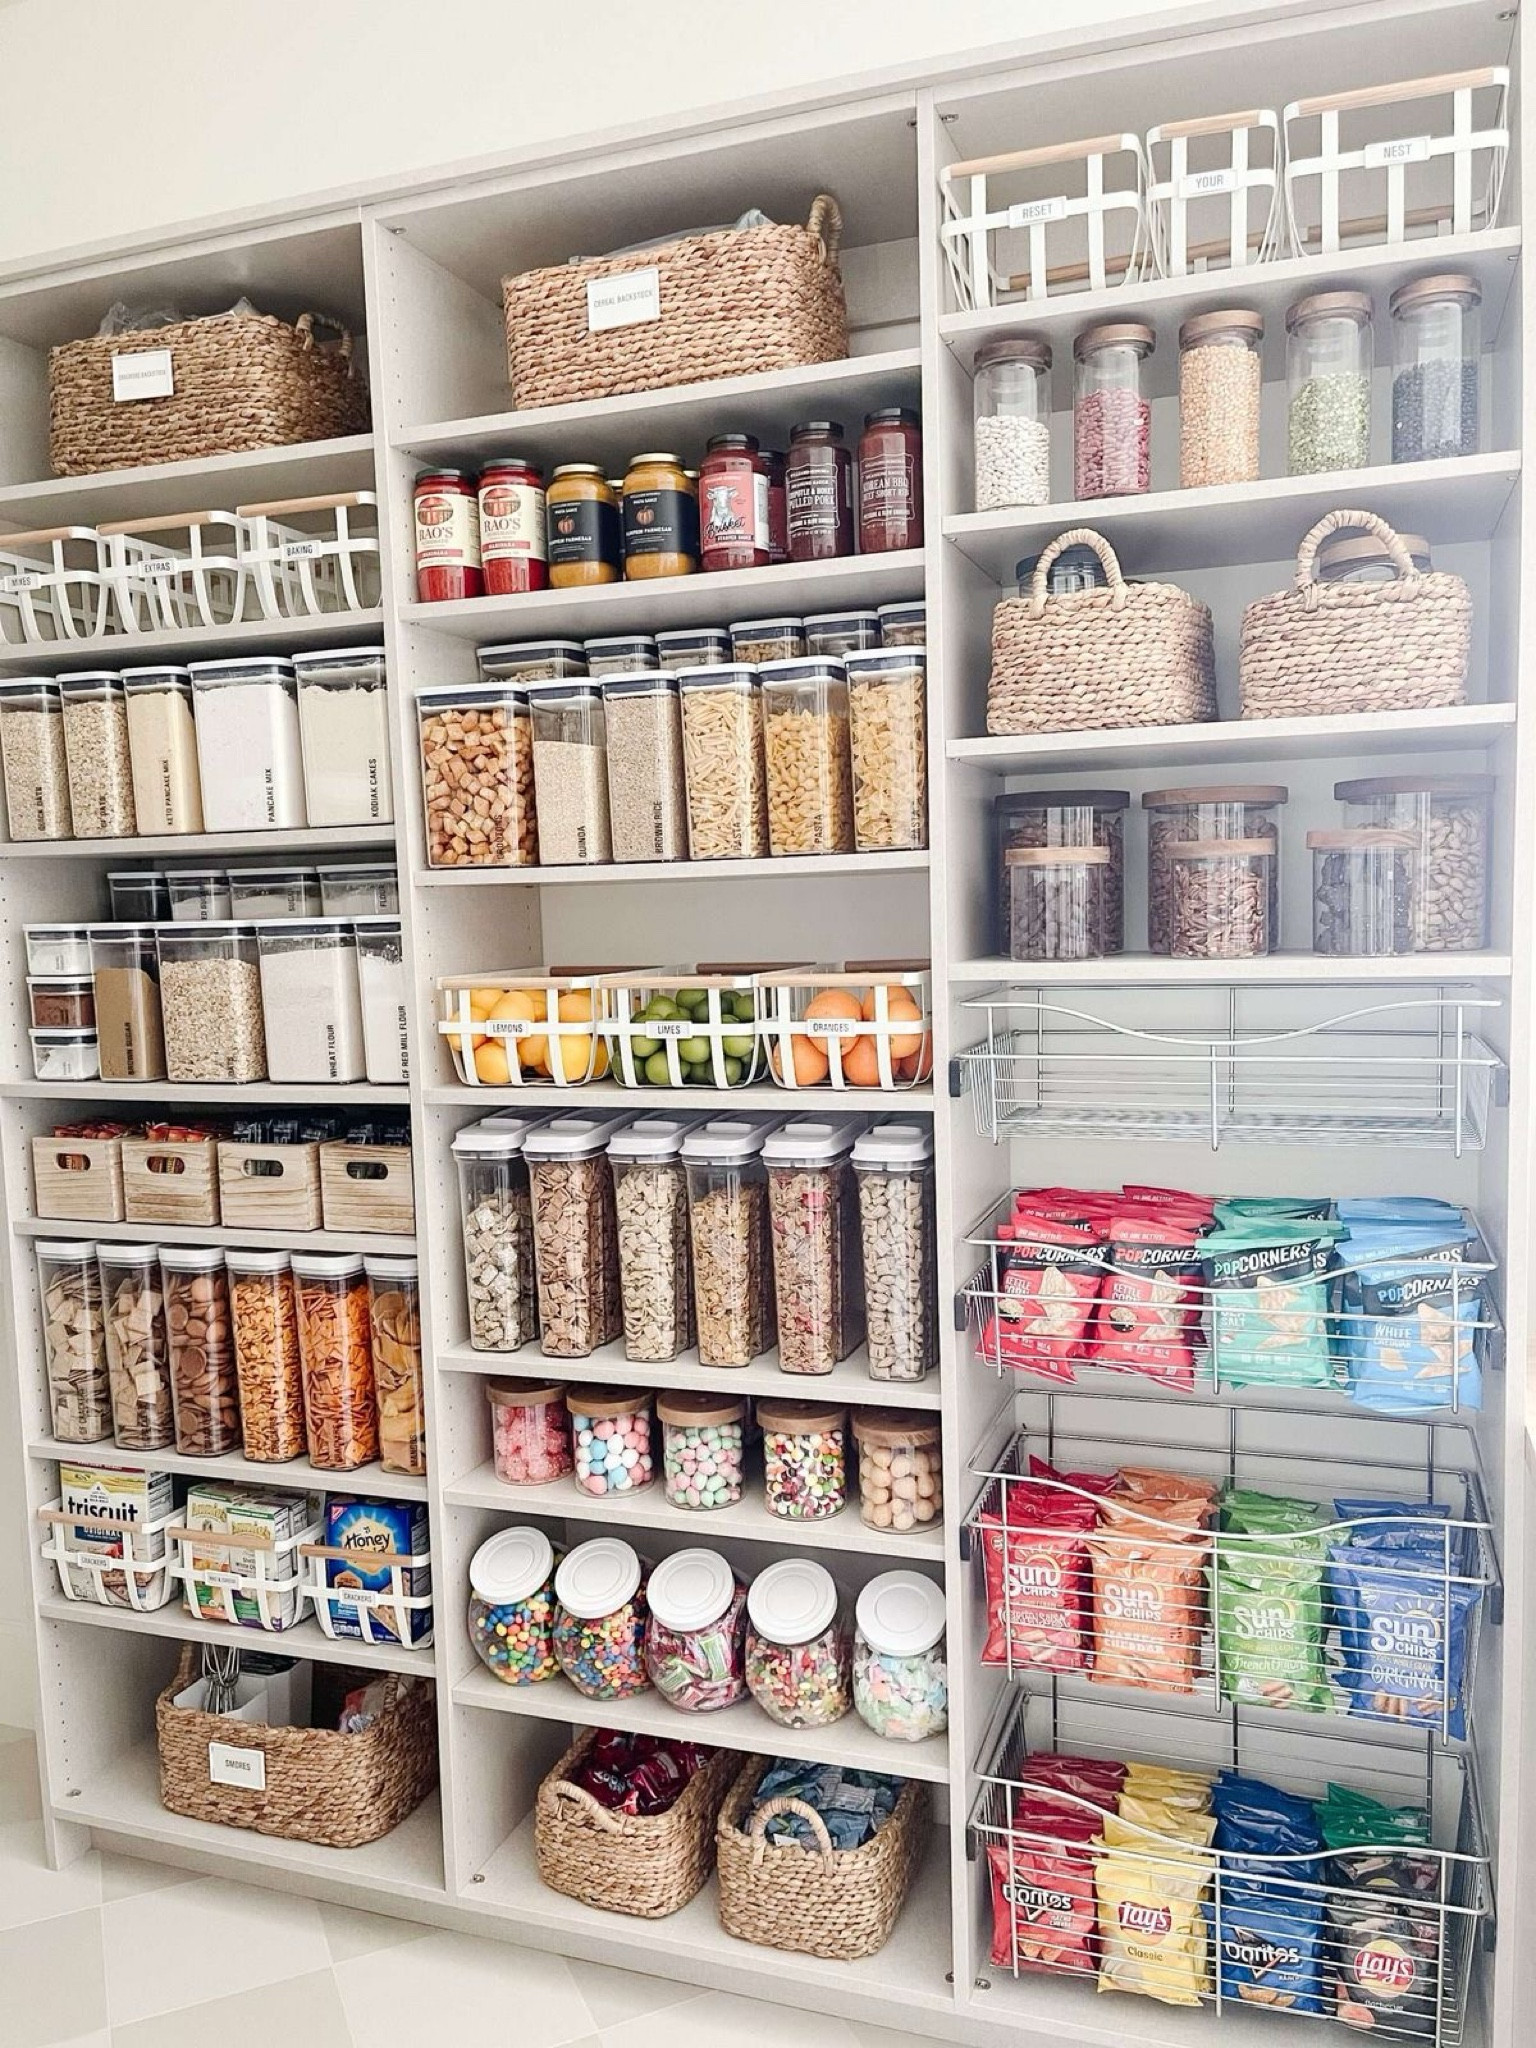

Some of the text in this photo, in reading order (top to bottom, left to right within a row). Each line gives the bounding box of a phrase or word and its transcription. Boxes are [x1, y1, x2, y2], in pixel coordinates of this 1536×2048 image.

[1383, 143, 1412, 158] NEST
[1195, 173, 1224, 188] YOUR
[1022, 202, 1053, 219] RESET
[419, 526, 453, 541] RAO'S
[484, 518, 521, 533] RAO'S
[286, 544, 313, 556] BAKING
[144, 561, 171, 572] EXTRAS
[163, 775, 171, 806] PANCAKE
[264, 768, 275, 823] PANCAKE MIX
[368, 758, 379, 818] KODIAK CAKES
[165, 808, 173, 826] KETO
[654, 822, 663, 854] BROWN
[731, 822, 741, 851] PASTA
[813, 814, 822, 844] PASTA
[576, 825, 586, 858] QUINOA
[398, 1005, 407, 1030] FLOUR
[492, 1023, 523, 1035] LEMONS
[656, 1025, 682, 1035] LIMES
[813, 1022, 849, 1034] ORANGES
[124, 1022, 135, 1076] BROWN SUGAR
[400, 1032, 408, 1050] MILL
[326, 1024, 337, 1078] WHEAT FLOUR
[401, 1051, 409, 1067] RED
[1013, 1244, 1107, 1263] POPCORNERS
[1115, 1247, 1202, 1264] POPCORNER
[1214, 1242, 1312, 1277] POPCORNERS
[1005, 1276, 1032, 1290] KETTLE
[1113, 1283, 1142, 1297] KETTLE
[1375, 1324, 1412, 1338] WHITE
[68, 1496, 138, 1522] triscuit
[344, 1532, 390, 1550] Honey
[1022, 1586, 1059, 1598] CHIPS
[1103, 1583, 1162, 1616] Sun
[1123, 1607, 1162, 1621] CHIPS
[1233, 1605, 1295, 1640] Sun
[1255, 1627, 1295, 1640] CHIPS
[1371, 1616, 1440, 1652] Sun
[1394, 1641, 1437, 1659] CHIPS
[1003, 1884, 1072, 1910] Doritos
[1120, 1902, 1171, 1935] Lay's
[1127, 1945, 1164, 1962] Classic
[1225, 1941, 1300, 1964] Doritos
[1359, 1952, 1411, 1984] Lay's
